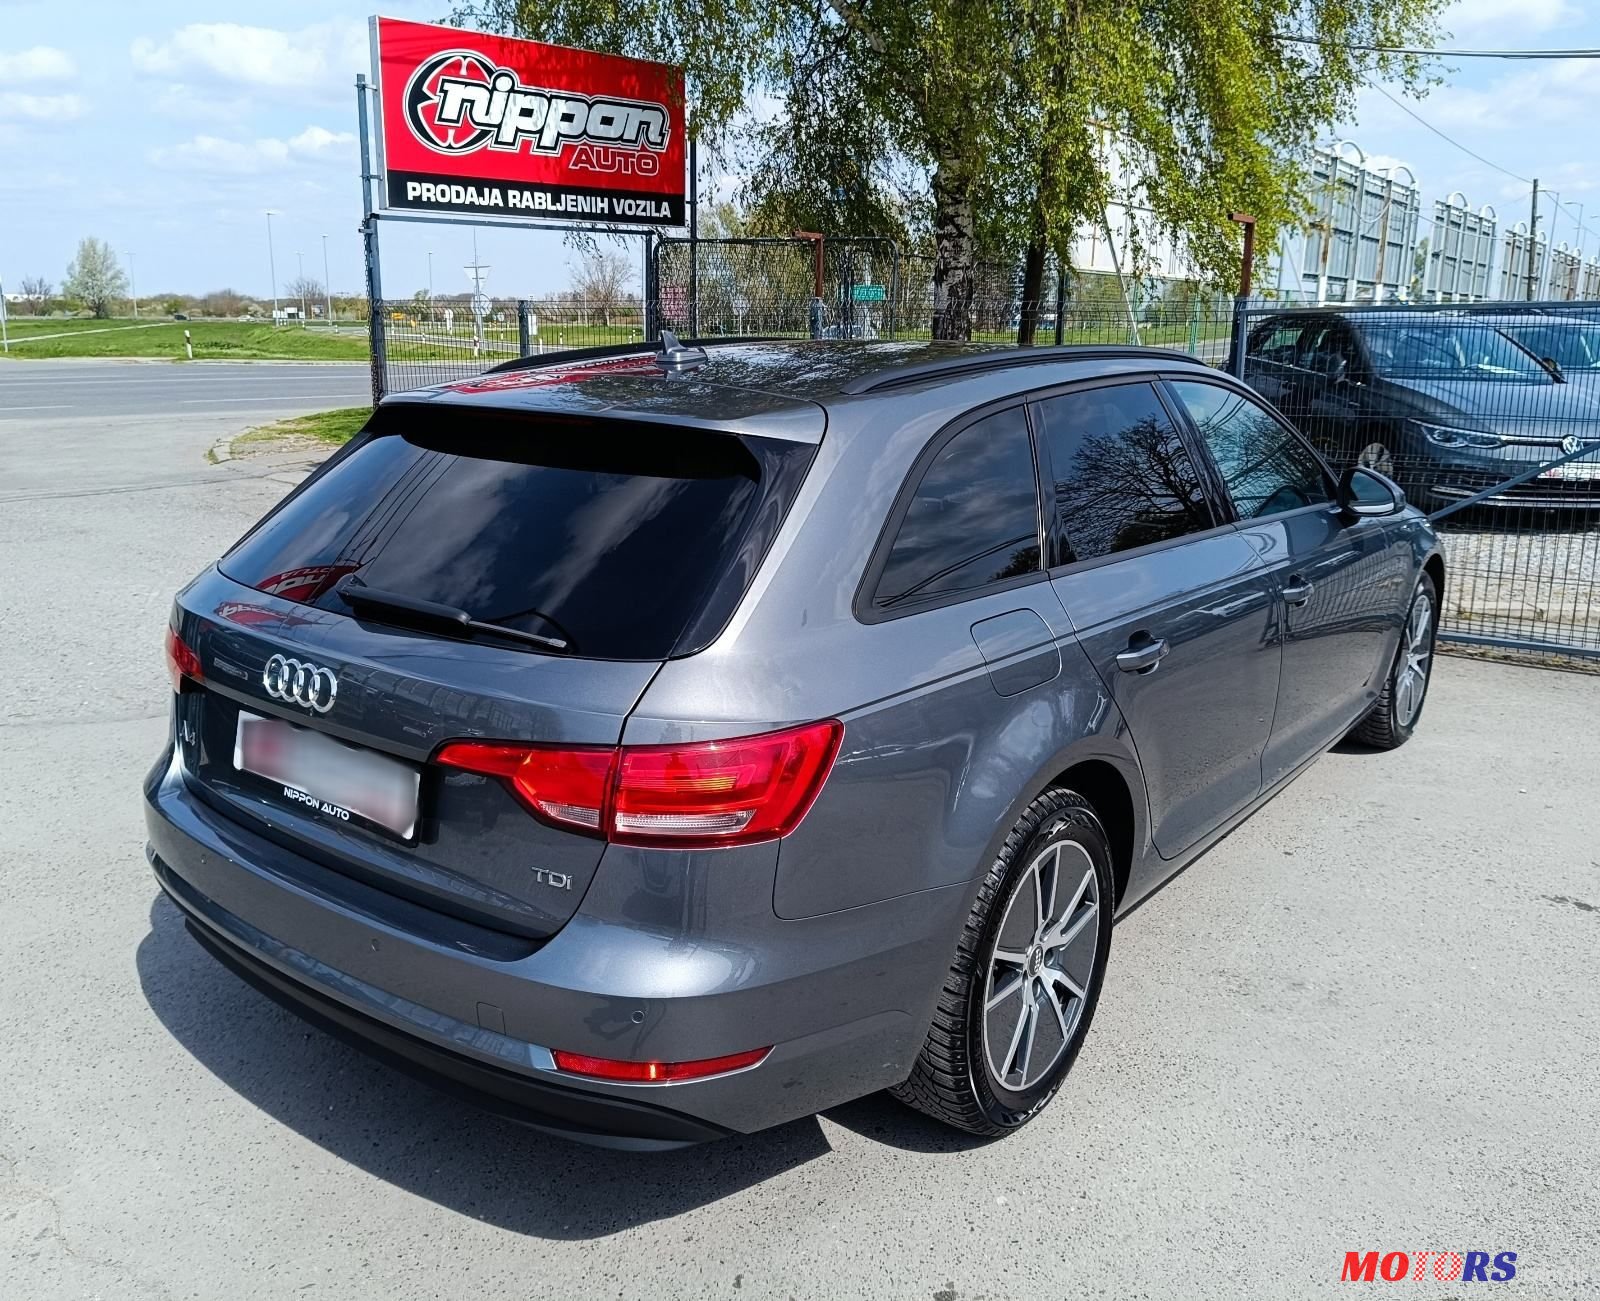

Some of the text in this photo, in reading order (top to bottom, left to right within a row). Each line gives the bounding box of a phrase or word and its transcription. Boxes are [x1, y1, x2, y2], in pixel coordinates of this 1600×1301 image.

[440, 75, 665, 149] nippon
[568, 146, 659, 176] AUTO
[406, 181, 671, 219] PRODAJA RABLJENIH VOZILA
[179, 719, 196, 746] A4
[283, 786, 350, 821] NIPPON AUTO
